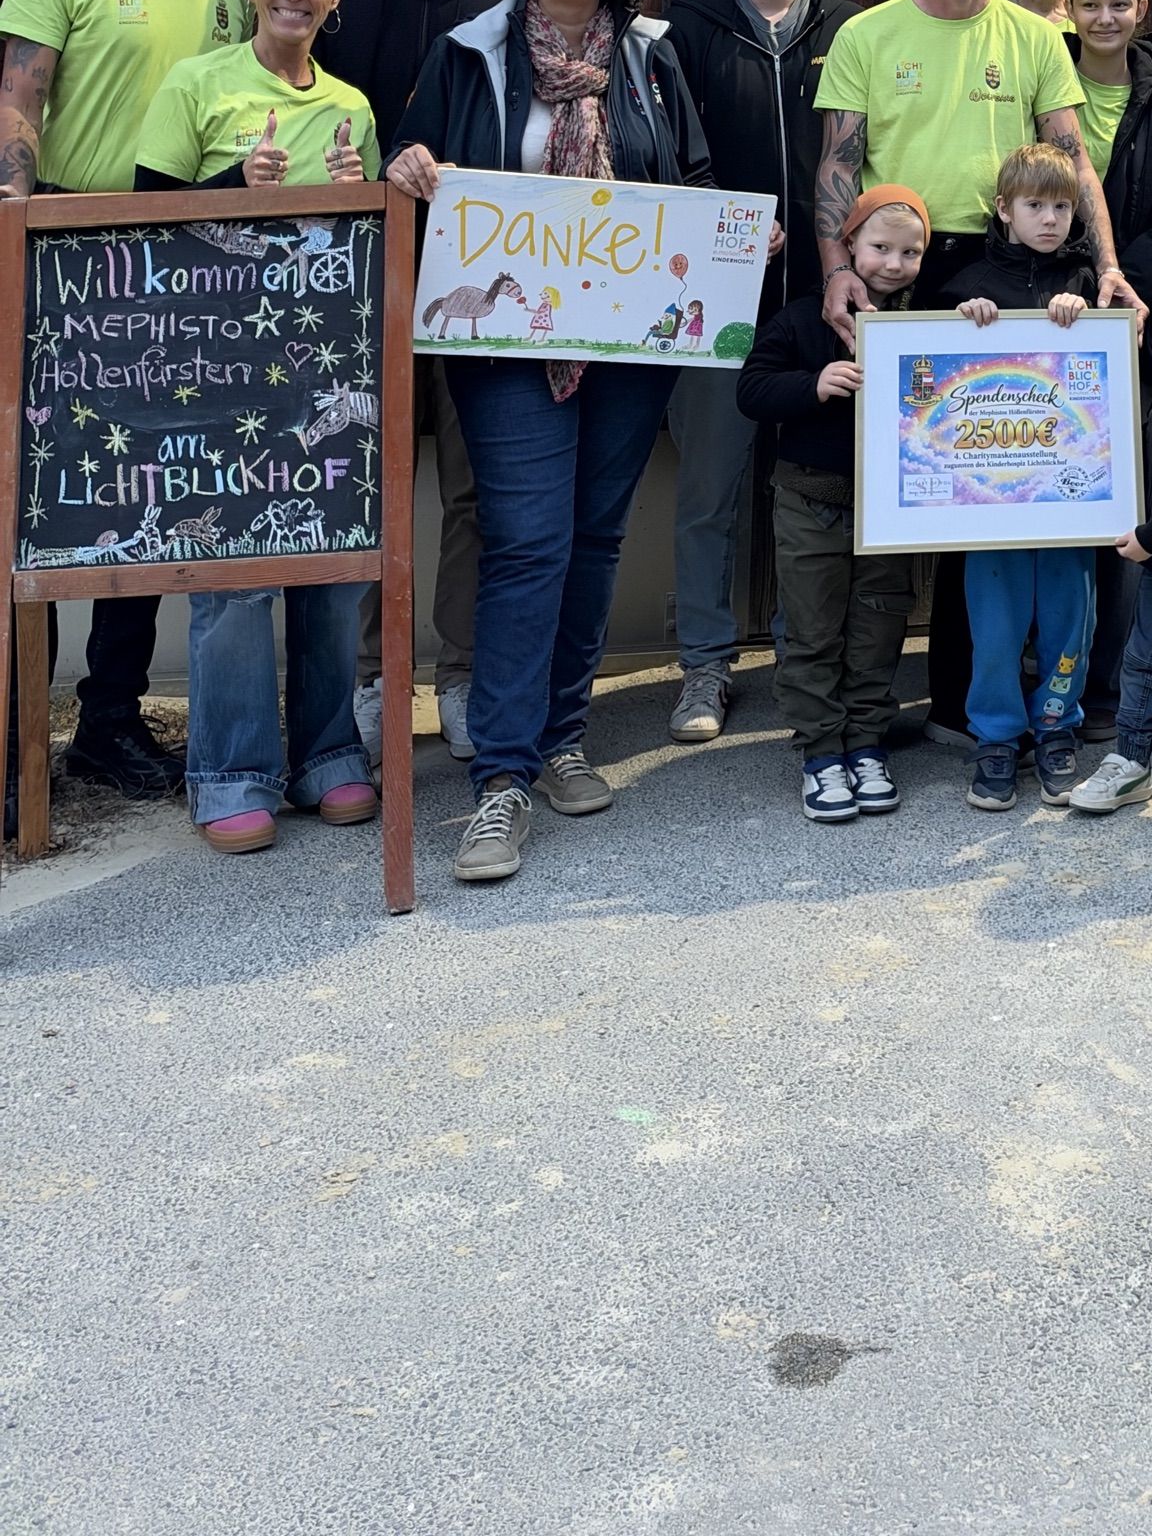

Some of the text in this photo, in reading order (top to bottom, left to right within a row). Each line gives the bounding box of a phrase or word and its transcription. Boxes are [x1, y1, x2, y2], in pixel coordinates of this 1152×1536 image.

[719, 207, 764, 222] LICHT
[717, 221, 760, 236] BLICK
[714, 235, 747, 249] HOF
[711, 257, 755, 265] KINDERHOSPIZ
[53, 241, 300, 305] Willkommen
[63, 312, 242, 344] MEPHISTO
[1068, 360, 1098, 370] LICHT
[1068, 371, 1098, 381] BLICK
[1069, 381, 1091, 391] HOF
[946, 383, 1065, 415] Spendenscheck
[954, 417, 1058, 449] 2500€
[157, 434, 208, 463] am
[963, 450, 1058, 461] Charitymaskenausstellung
[987, 460, 1026, 469] Kinderhospiz
